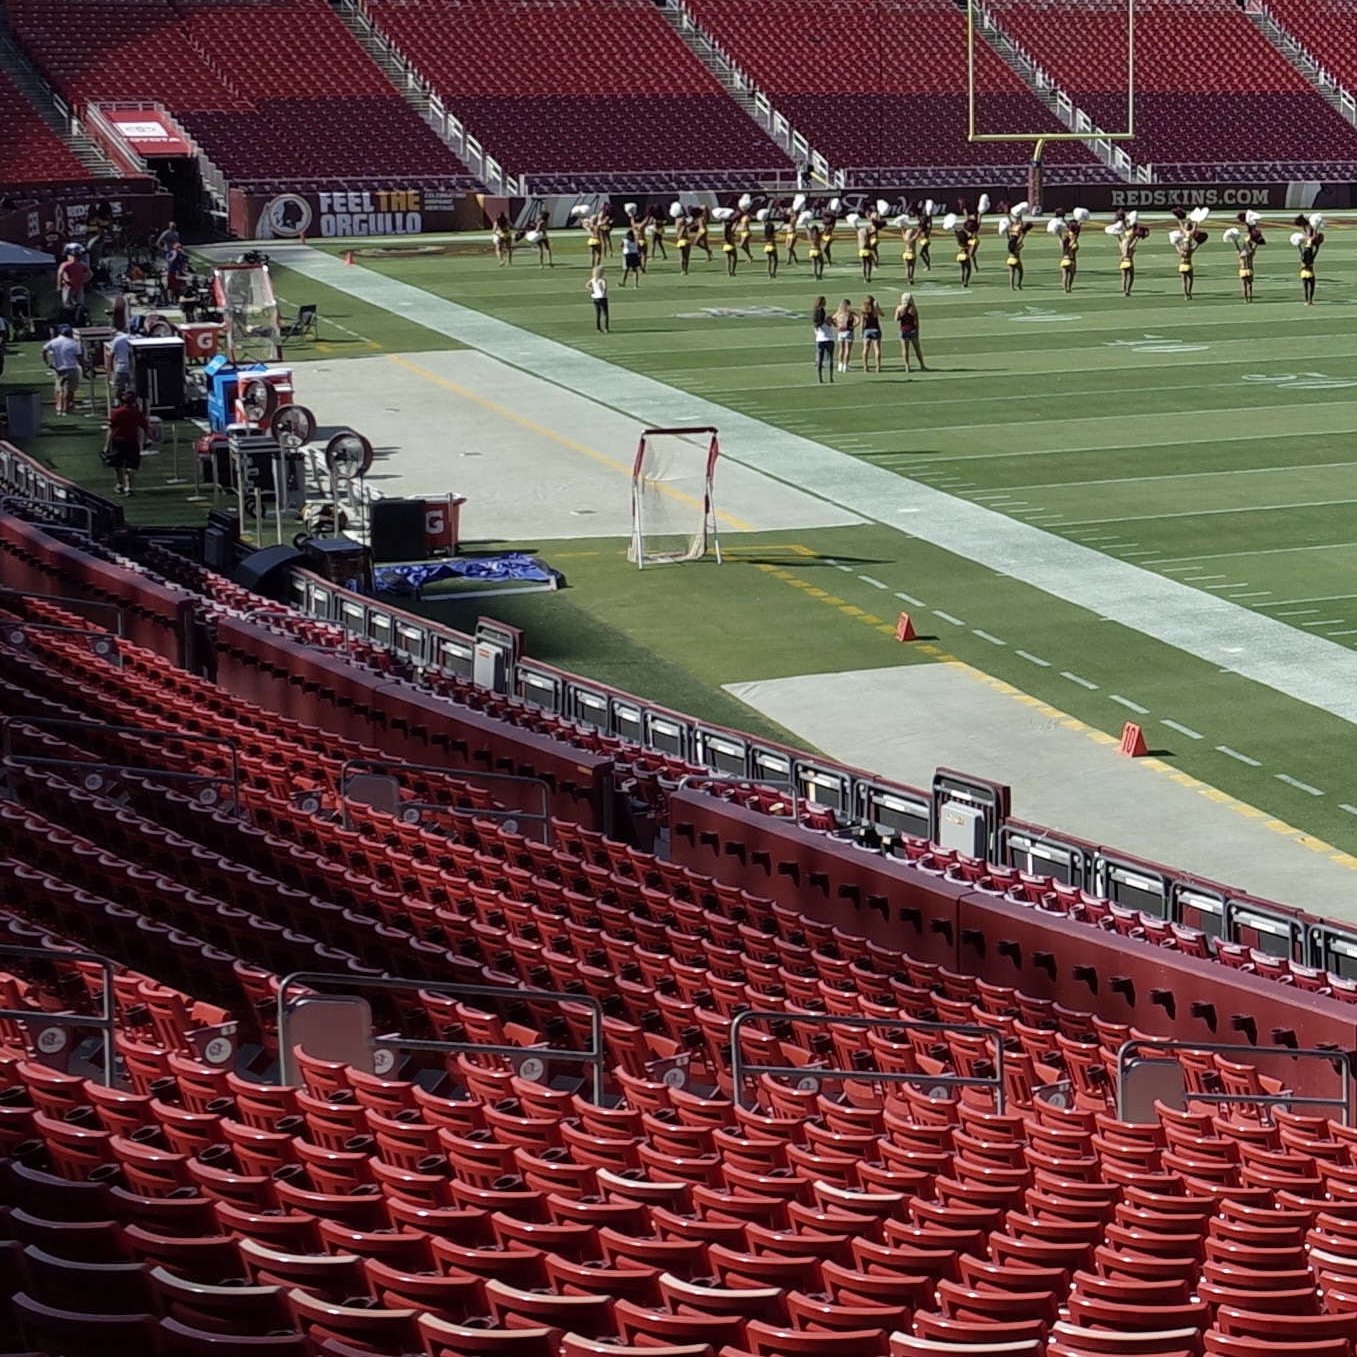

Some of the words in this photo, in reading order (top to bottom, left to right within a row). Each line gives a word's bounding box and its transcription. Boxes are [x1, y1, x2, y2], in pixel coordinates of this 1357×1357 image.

[318, 192, 375, 213] FEEL
[375, 190, 421, 212] THE
[1111, 189, 1269, 206] REDSKINS.COM
[319, 212, 422, 237] ORGULLO
[196, 332, 213, 349] G
[423, 509, 445, 537] G
[1121, 726, 1137, 753] 10
